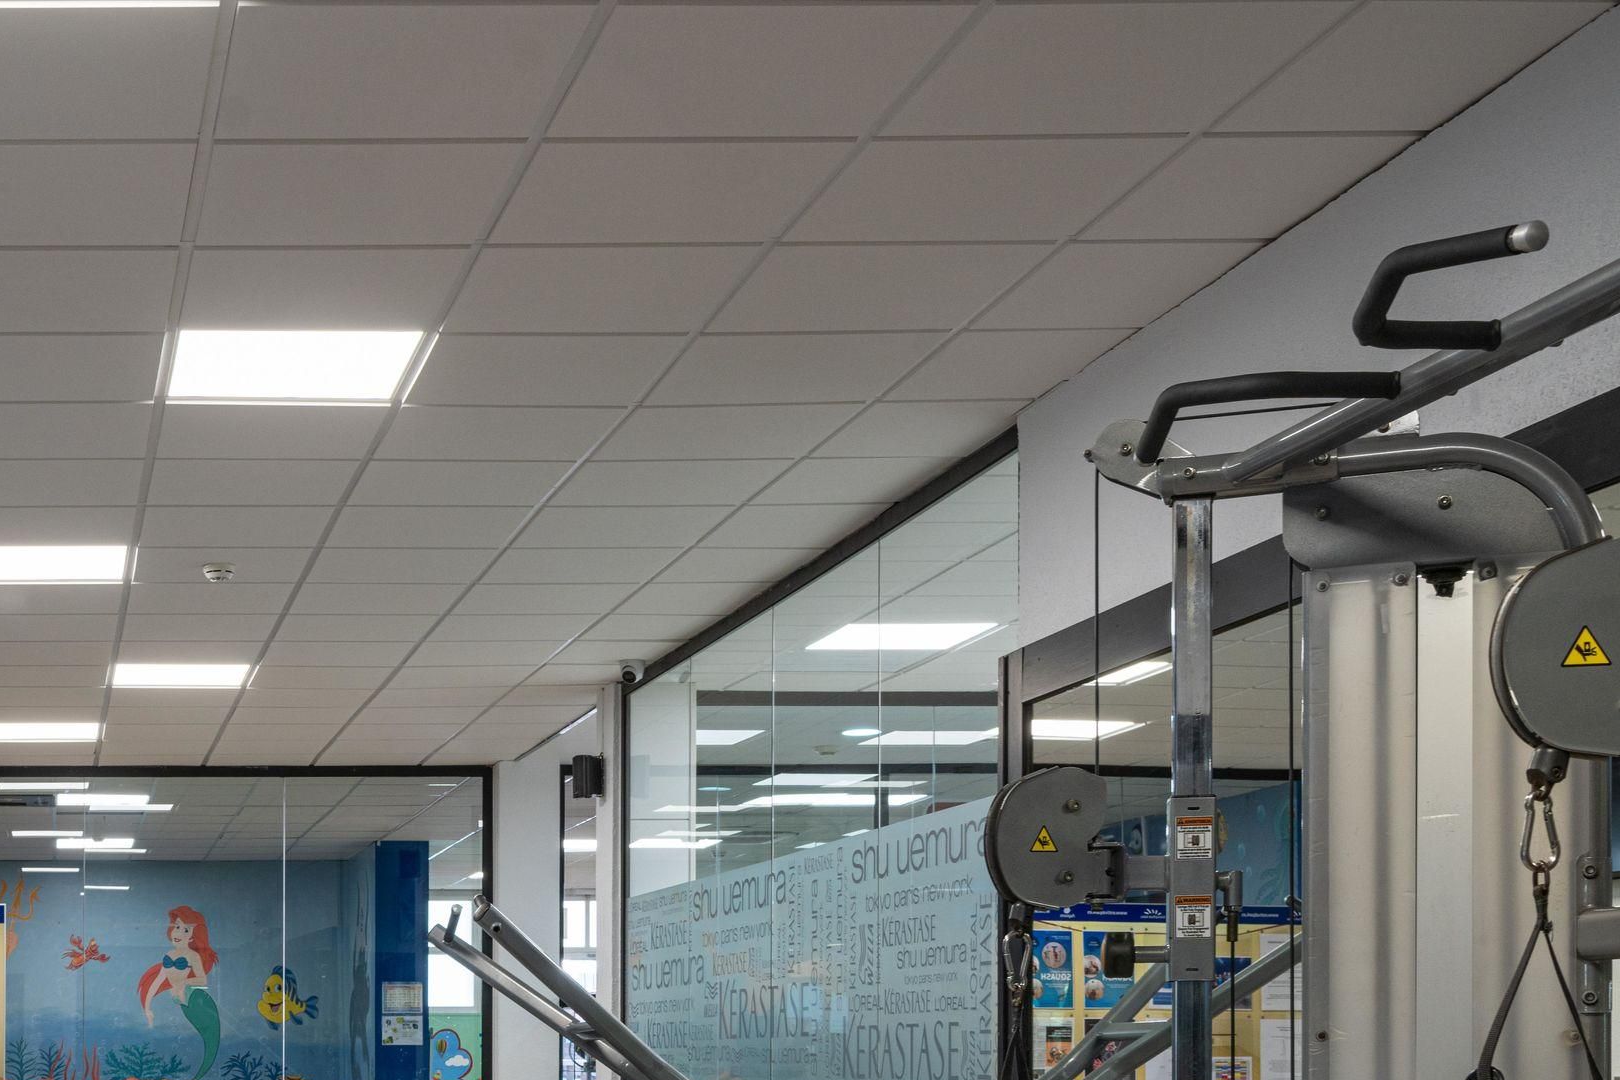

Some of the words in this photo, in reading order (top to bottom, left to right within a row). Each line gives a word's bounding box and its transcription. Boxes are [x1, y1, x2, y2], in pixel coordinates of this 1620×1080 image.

[851, 839, 889, 884] shu
[692, 884, 718, 922] shu
[722, 870, 786, 916] uemura
[632, 962, 652, 991] shu
[656, 954, 705, 988] uemura
[897, 947, 917, 970] shu
[921, 943, 967, 966] uemura
[719, 979, 810, 1040] KÉRASTASE
[842, 1013, 959, 1080] KÉRASTASE
